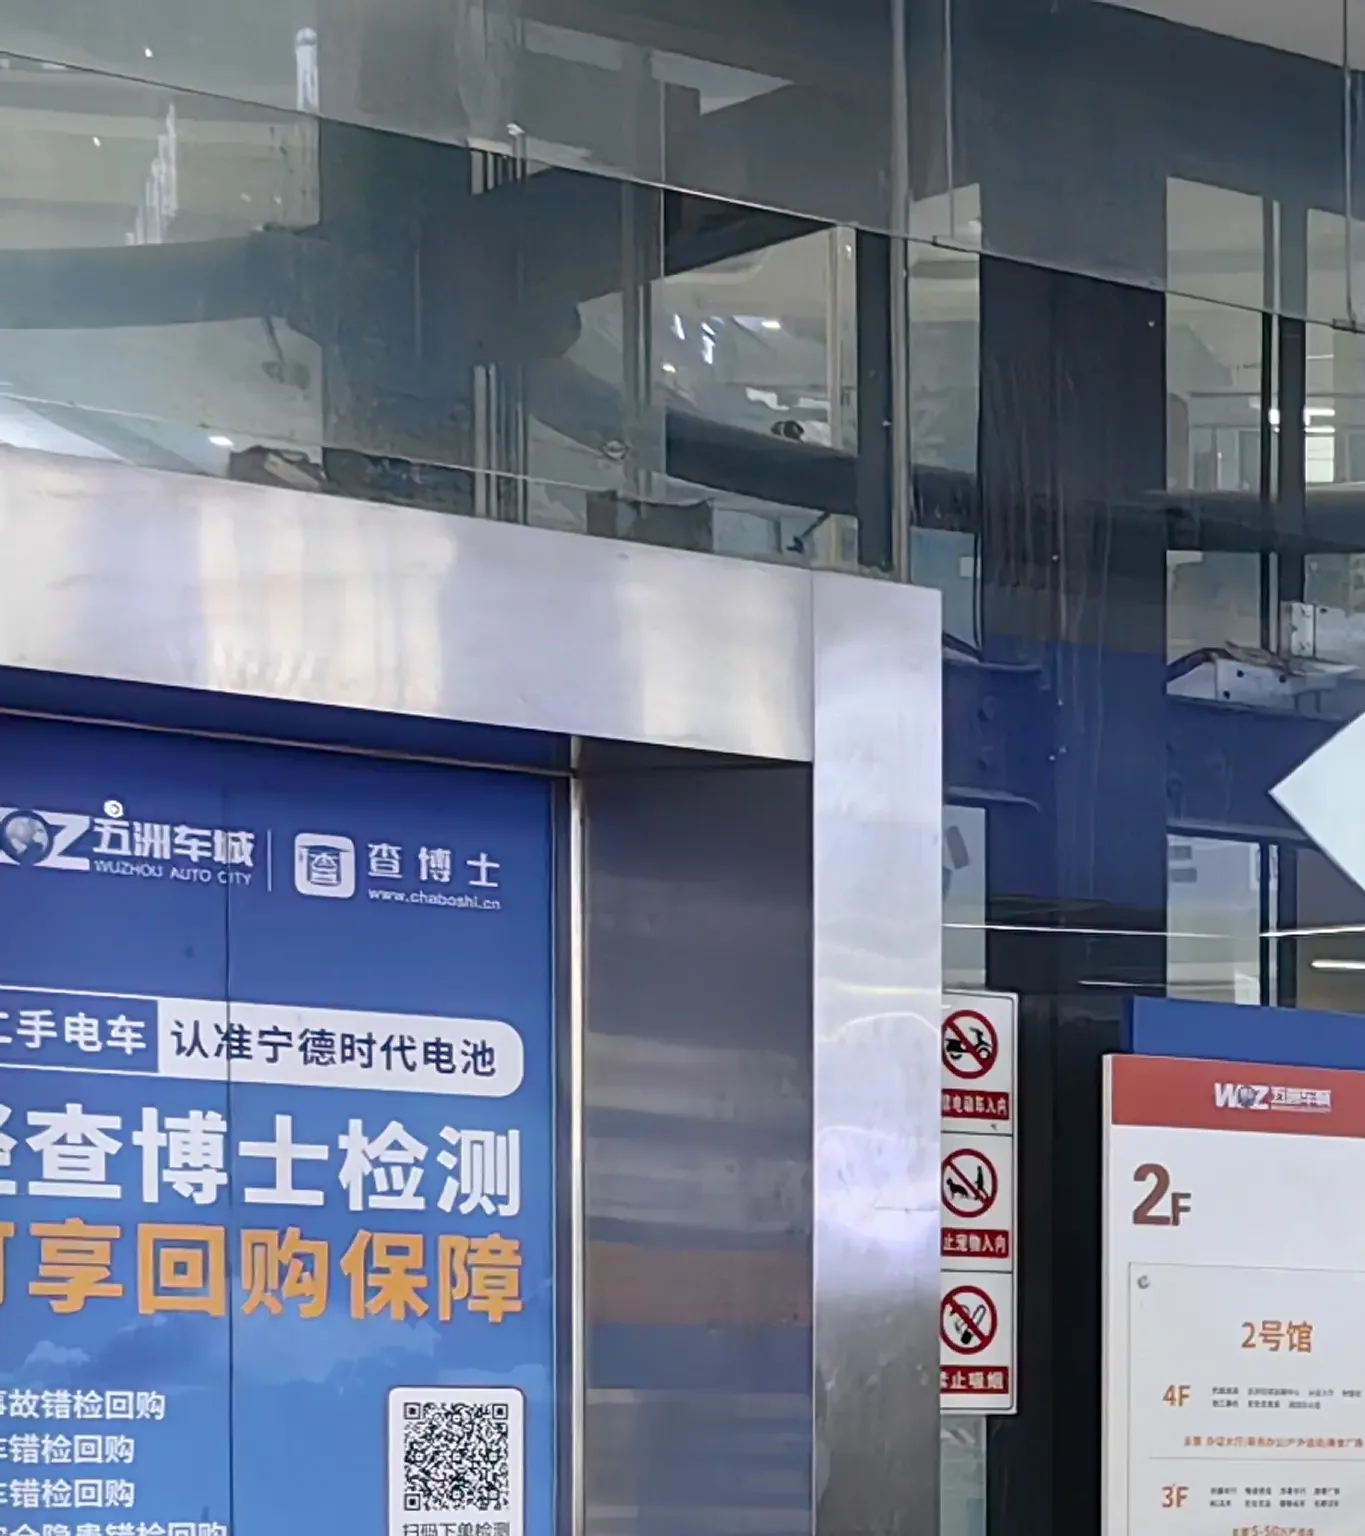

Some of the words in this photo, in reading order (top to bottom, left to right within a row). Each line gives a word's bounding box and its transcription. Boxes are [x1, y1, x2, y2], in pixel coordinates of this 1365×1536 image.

[93, 818, 255, 867] 五洲车城
[93, 859, 163, 878] WUZHOU
[170, 866, 212, 883] AUTO
[217, 870, 252, 886] CITY
[367, 842, 500, 888] 查博士
[367, 887, 501, 911] www.chaboshi.cn
[170, 1020, 497, 1078] 认准宁德时代电池
[0, 1103, 521, 1217] 查博士检测
[1132, 1163, 1192, 1227] 2F
[0, 1217, 523, 1323] 享回购保障
[1241, 1320, 1314, 1354] 2号馆
[0, 1389, 166, 1420] 故错检回购
[1162, 1384, 1191, 1408] 4F
[0, 1433, 135, 1464] 错检回购
[0, 1477, 135, 1508] 错检回购
[1161, 1485, 1190, 1509] 3F
